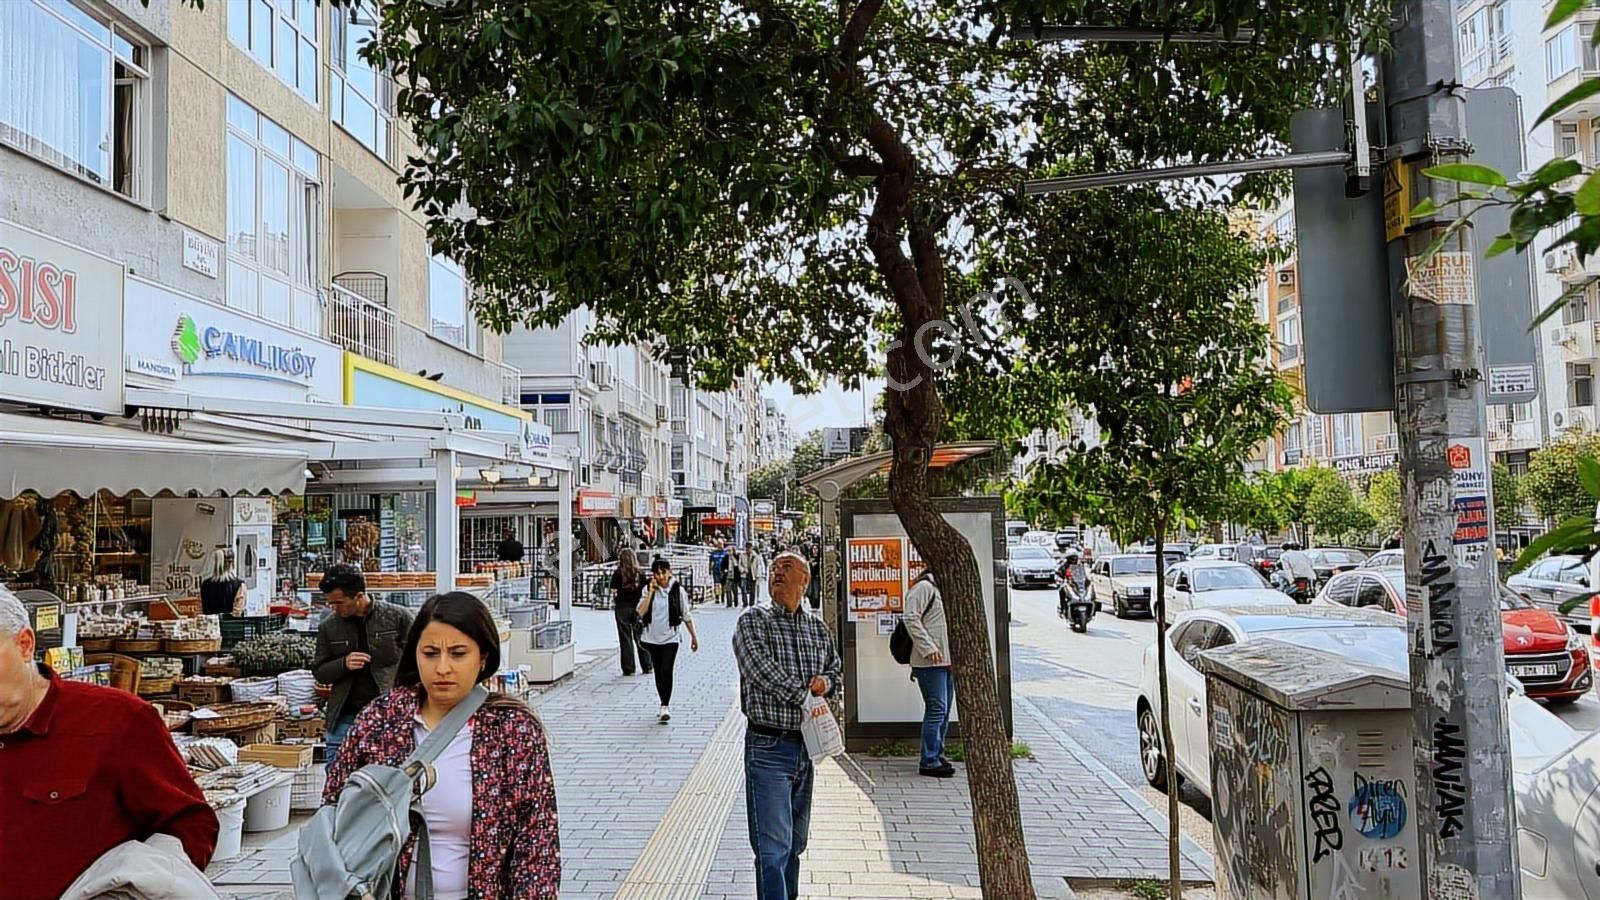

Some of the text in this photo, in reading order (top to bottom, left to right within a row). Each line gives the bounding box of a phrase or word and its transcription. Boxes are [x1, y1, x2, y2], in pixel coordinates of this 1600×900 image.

[203, 325, 317, 378] ÇAMLIKÖY
[25, 345, 106, 391] Bitkiler
[1364, 454, 1395, 468] HAIR
[850, 544, 884, 563] HALK
[1353, 771, 1408, 798] Diren
